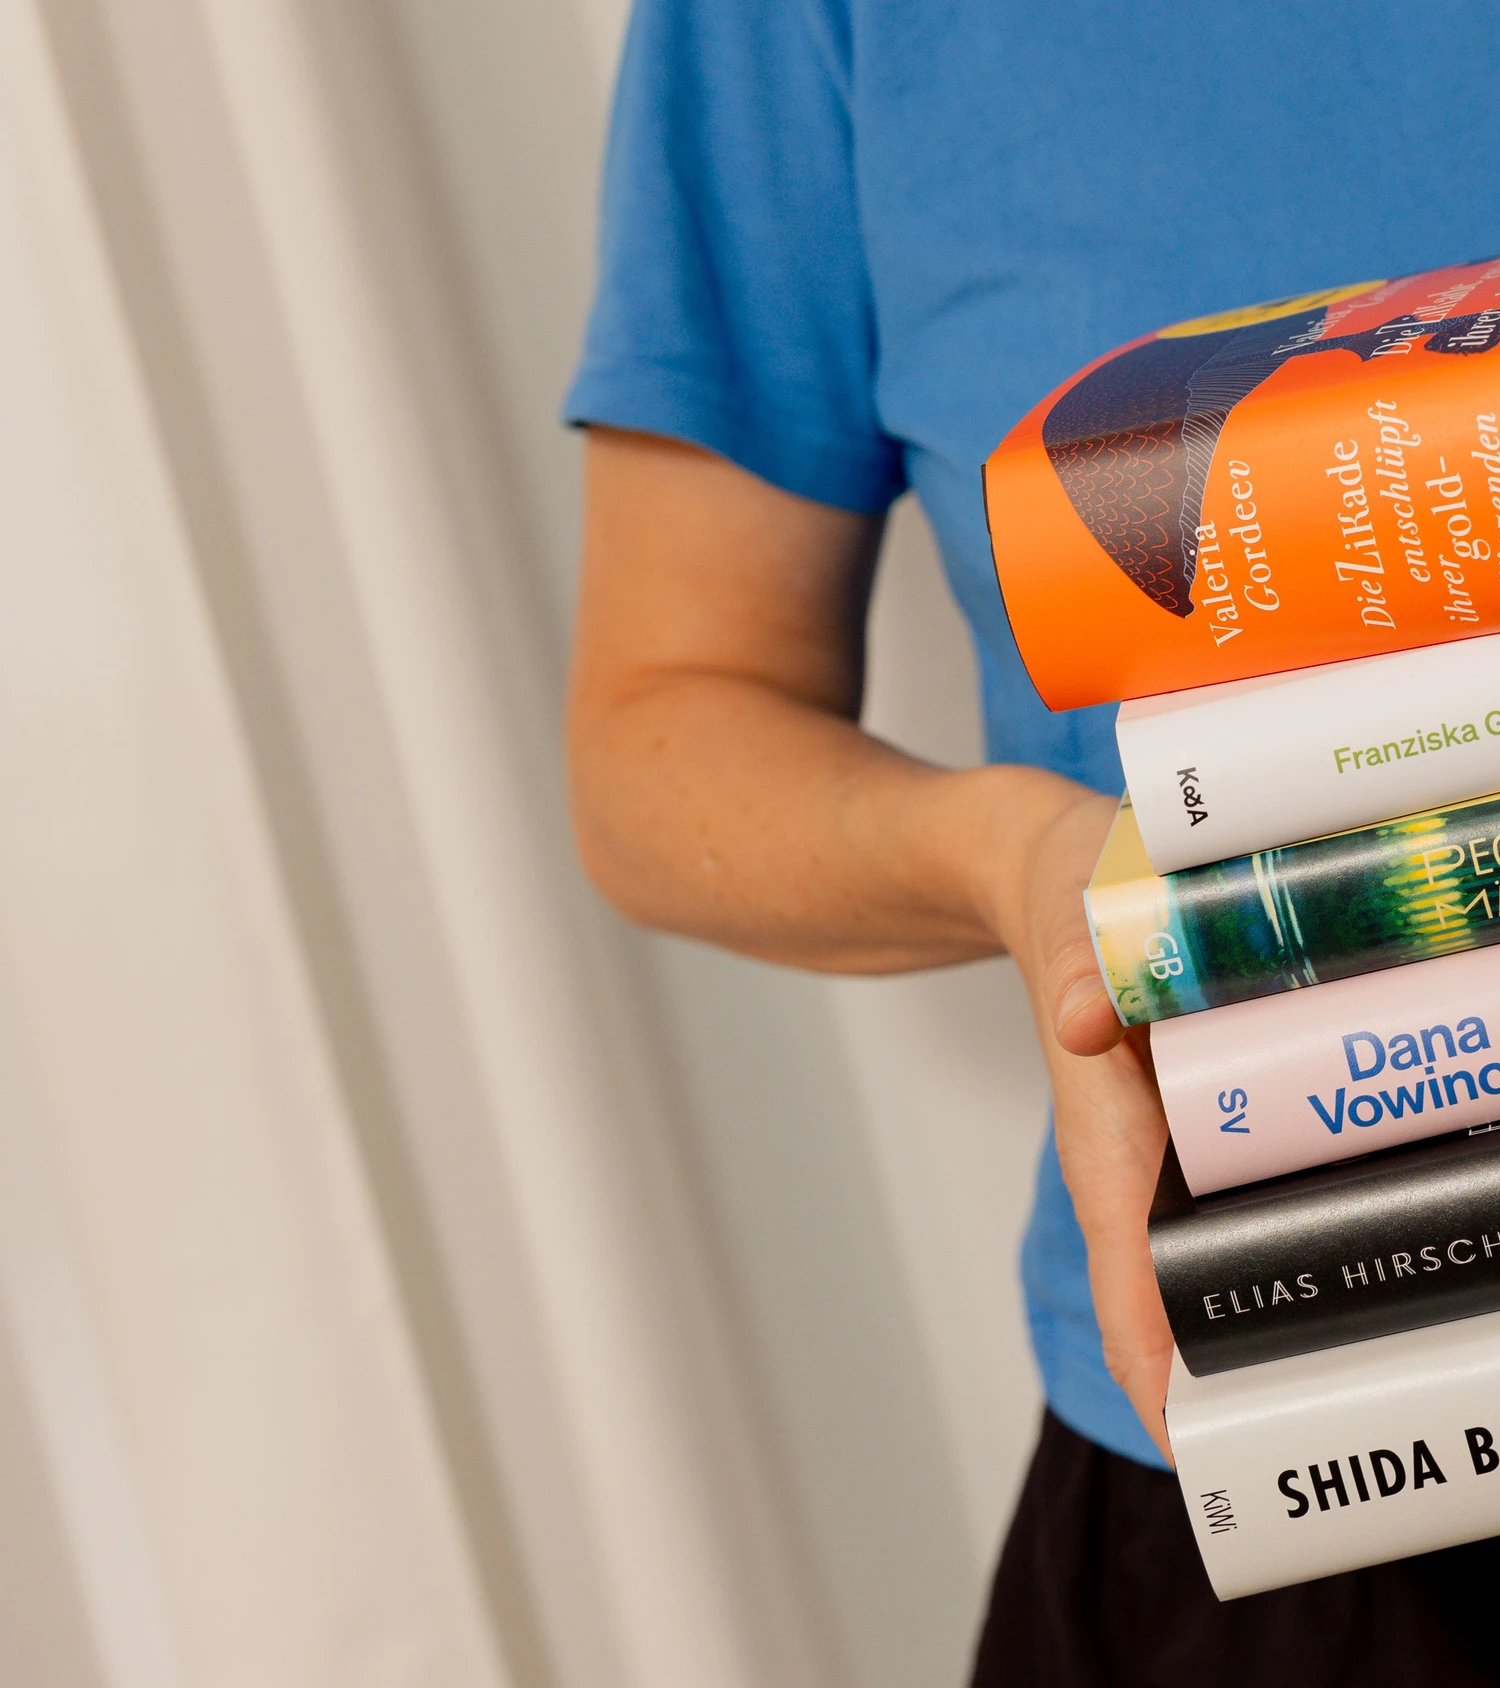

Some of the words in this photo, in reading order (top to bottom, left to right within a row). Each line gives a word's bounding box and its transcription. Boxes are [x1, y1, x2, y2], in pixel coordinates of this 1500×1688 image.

[1367, 398, 1432, 583] entschlüpft
[1424, 455, 1492, 562] gold-
[1228, 459, 1281, 612] Gordeev
[1189, 519, 1244, 648] Valeria
[1356, 579, 1398, 630] Die
[1438, 554, 1480, 623] ihrer
[1333, 722, 1480, 775] Franziska
[1176, 766, 1209, 827] K&A
[1143, 931, 1184, 981] GB
[1341, 1014, 1492, 1083] Dana
[1217, 1087, 1251, 1134] SV
[1202, 1273, 1320, 1321] ELIAS
[1275, 1438, 1448, 1519] SHIDA
